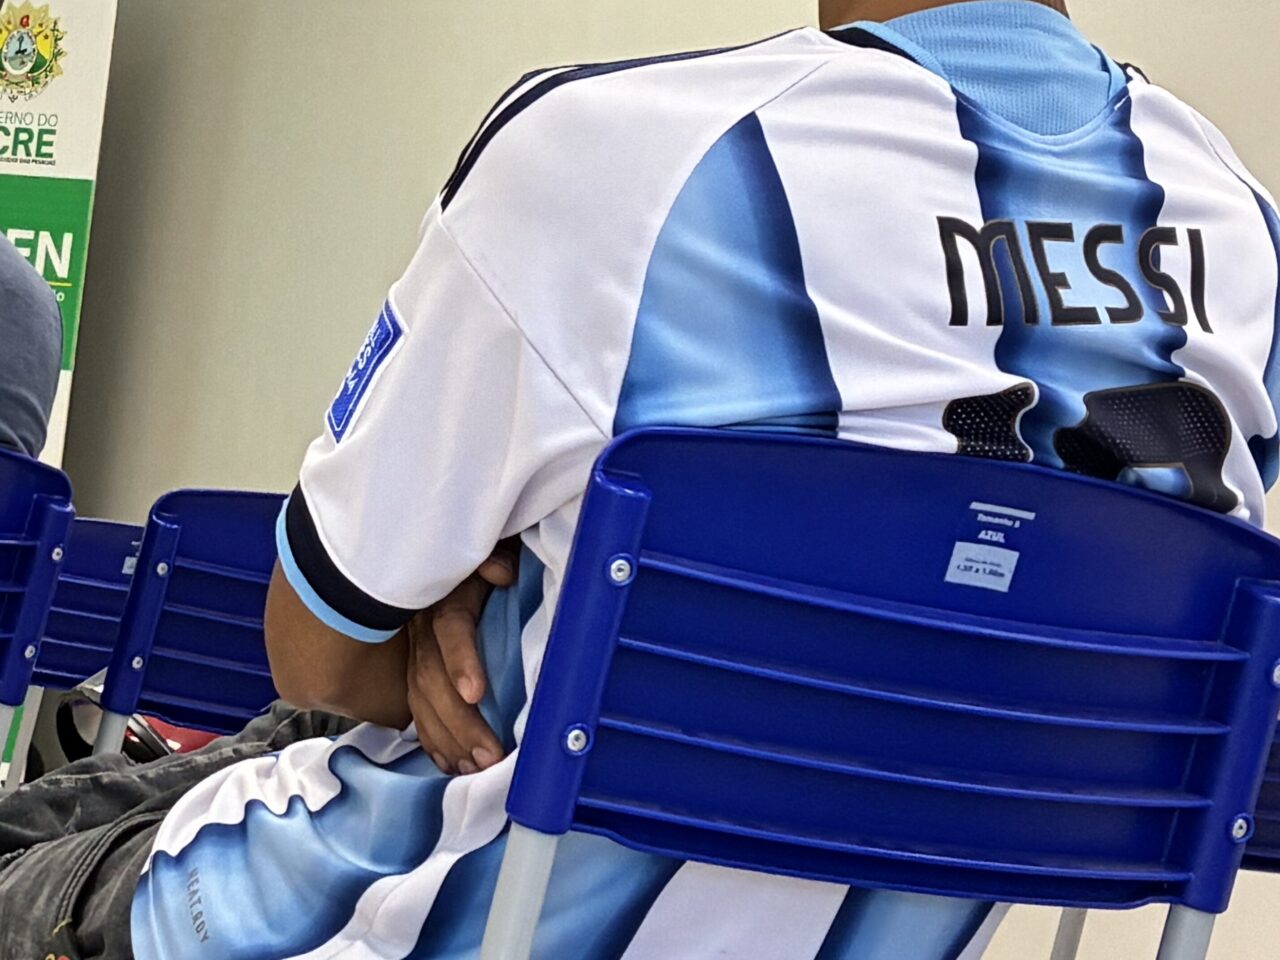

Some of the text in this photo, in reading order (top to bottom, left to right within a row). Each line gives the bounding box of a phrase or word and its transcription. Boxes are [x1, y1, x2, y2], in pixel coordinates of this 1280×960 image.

[37, 113, 58, 127] DO
[936, 216, 1214, 334] MESSI
[977, 529, 1005, 543] AZUL
